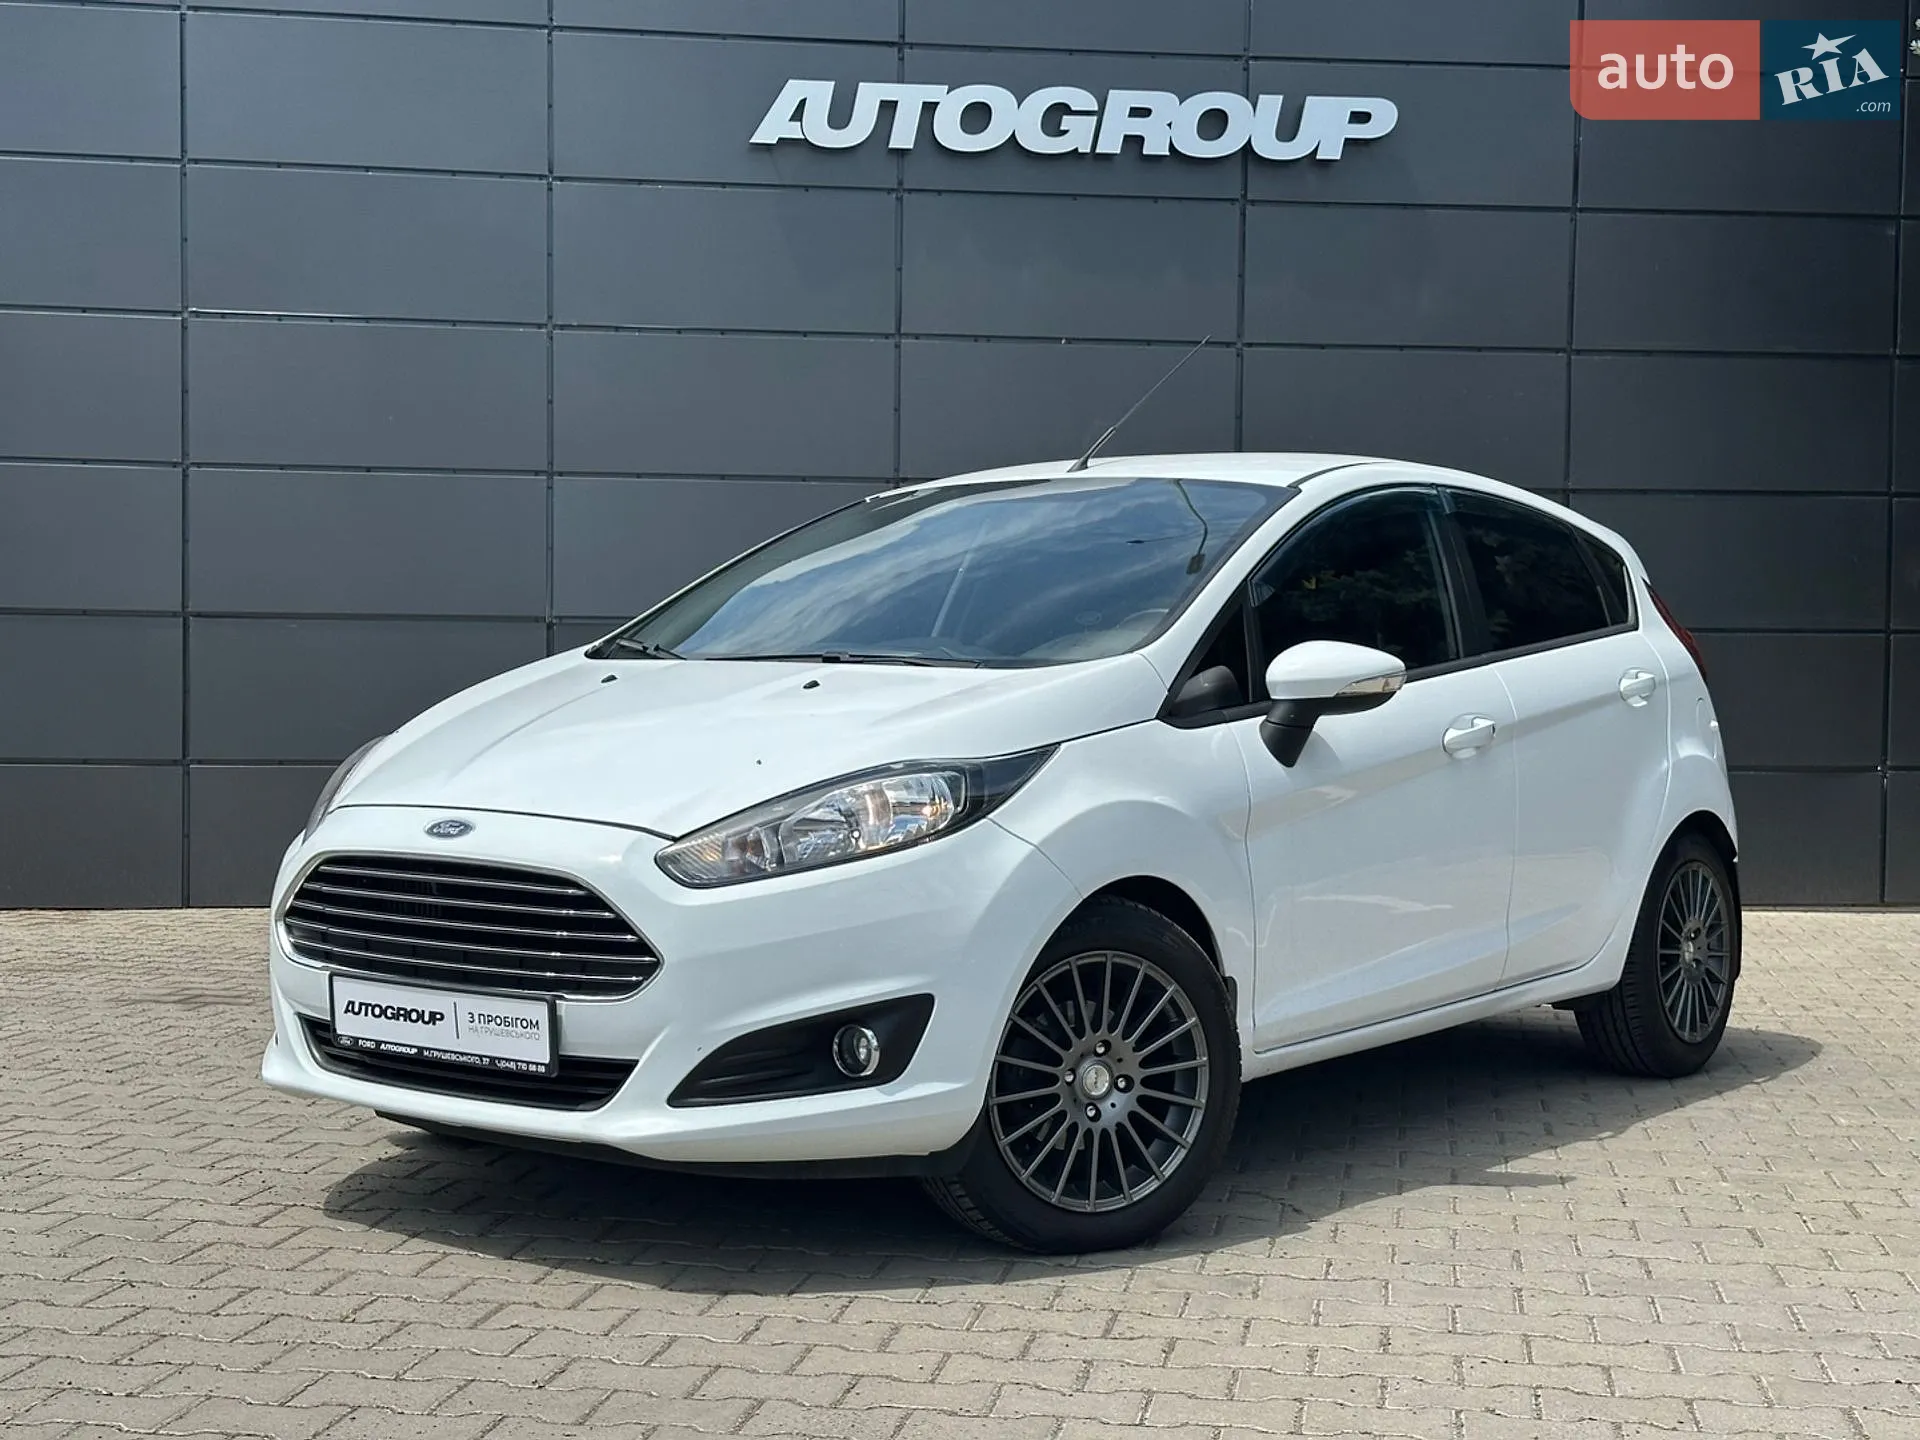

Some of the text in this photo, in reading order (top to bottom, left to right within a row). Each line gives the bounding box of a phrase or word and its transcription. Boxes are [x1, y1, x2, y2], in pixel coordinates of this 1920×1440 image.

[750, 79, 1399, 160] AUTOGROUP
[344, 1000, 445, 1026] AUTOGROUP
[478, 1013, 540, 1031] ПРОБІГОМ
[359, 1039, 376, 1049] FORD
[380, 1042, 418, 1055] AUTOGROUP
